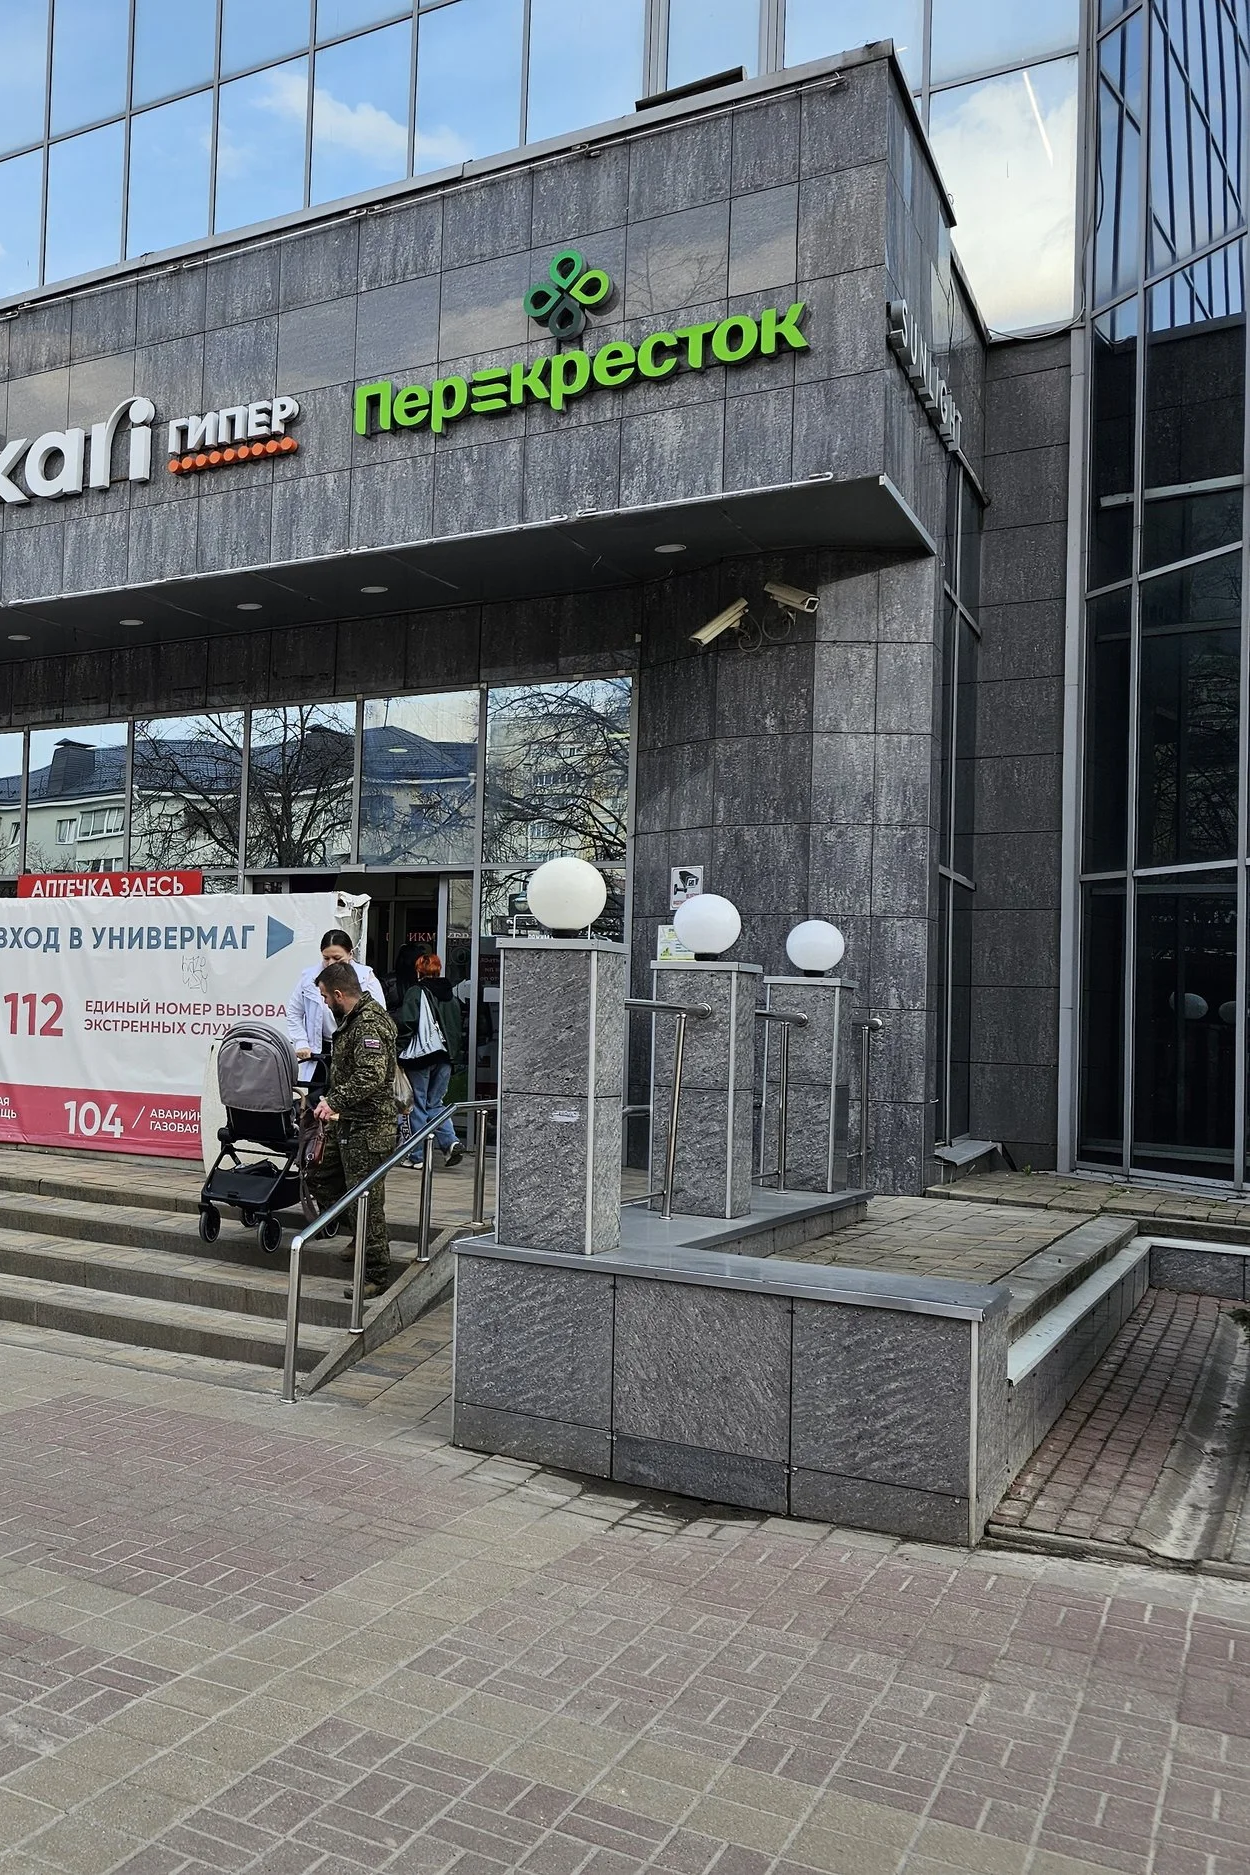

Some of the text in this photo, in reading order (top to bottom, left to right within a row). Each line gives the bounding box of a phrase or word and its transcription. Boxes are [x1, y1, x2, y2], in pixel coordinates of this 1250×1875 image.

[354, 302, 810, 435] Перекресток
[890, 299, 963, 451] SUNLIGHT
[168, 396, 299, 455] ГИПЕР
[31, 875, 184, 897] АПТЕЧКА ЗДЕСЬ
[69, 927, 83, 949] В
[91, 925, 255, 950] УНИВЕРМАГ
[3, 992, 64, 1037] 112
[85, 998, 287, 1018] ЕДИНЫЙ НОМЕР ВЫЗОВА
[84, 1018, 186, 1035] ЭКСТРЕННЫХ
[63, 1100, 124, 1138] 104
[150, 1120, 199, 1134] ГАЗОВАЯ
